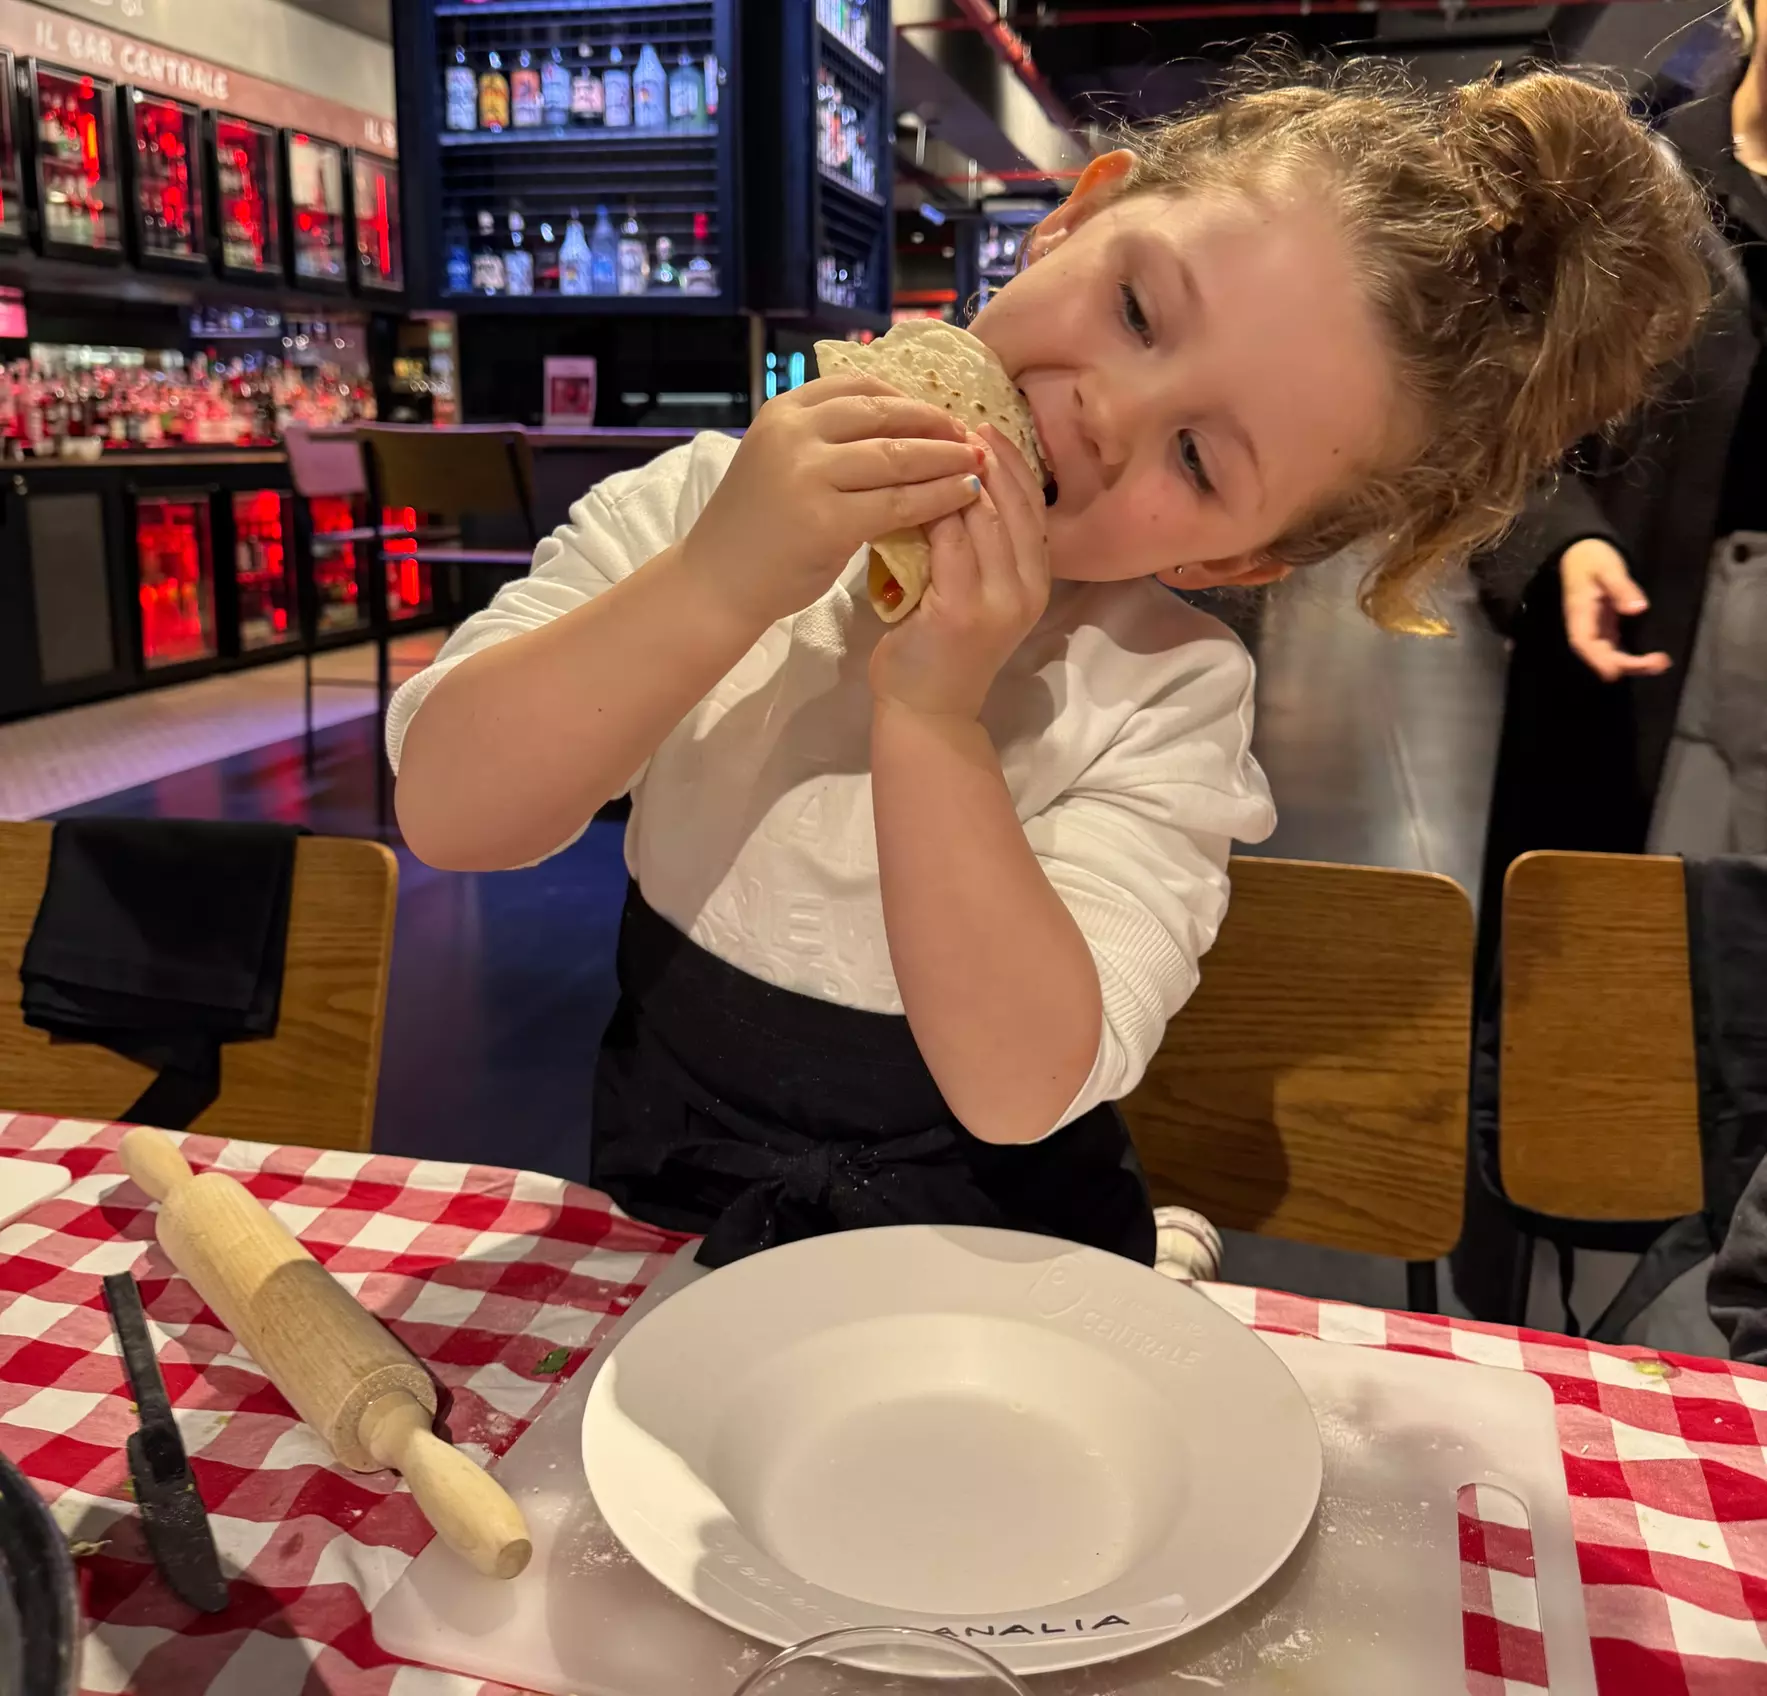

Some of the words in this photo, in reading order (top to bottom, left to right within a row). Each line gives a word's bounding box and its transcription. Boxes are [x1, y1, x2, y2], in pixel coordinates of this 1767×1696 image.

[36, 20, 59, 51] IL
[67, 27, 114, 67] BAR
[120, 43, 229, 100] CENTRALE
[364, 117, 381, 145] IL
[1082, 1309, 1201, 1370] CENTRALE
[932, 1613, 1130, 1638] ANALIA
